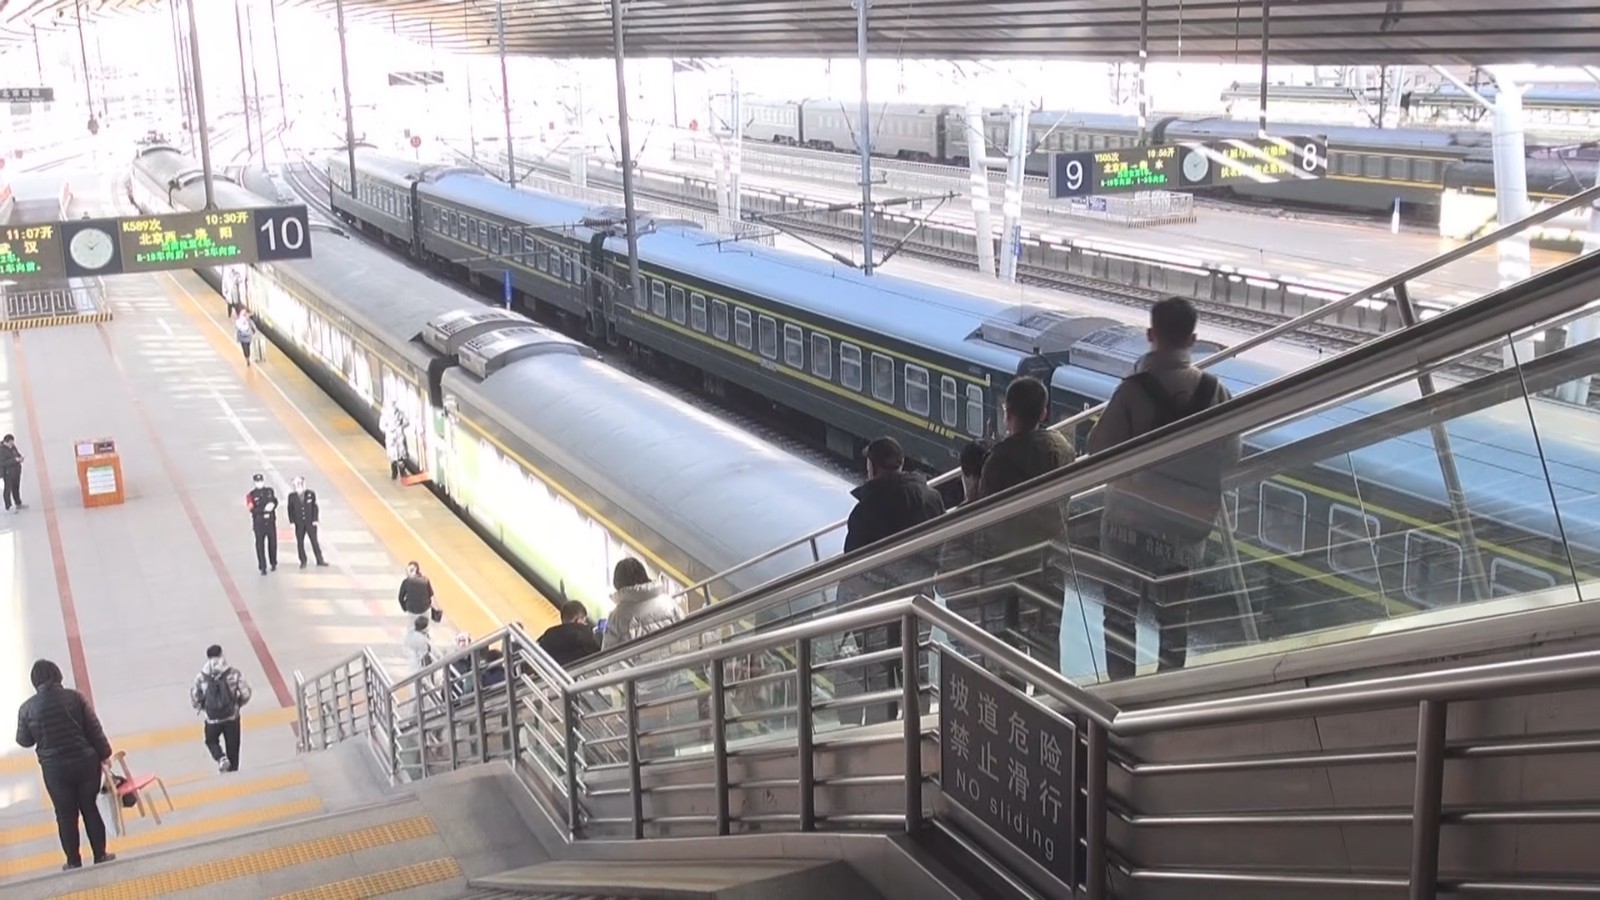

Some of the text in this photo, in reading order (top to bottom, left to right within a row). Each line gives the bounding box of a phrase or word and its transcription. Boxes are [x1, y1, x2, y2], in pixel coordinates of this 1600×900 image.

[1302, 143, 1318, 171] 8
[1066, 160, 1083, 190] 9
[6, 225, 54, 241] 11:07开
[122, 210, 249, 232] K589次 10:30开
[260, 216, 304, 251] 10
[949, 673, 1062, 776] 坡道危险
[949, 720, 1063, 825] 禁止滑行
[956, 768, 1055, 861] NO sliding
